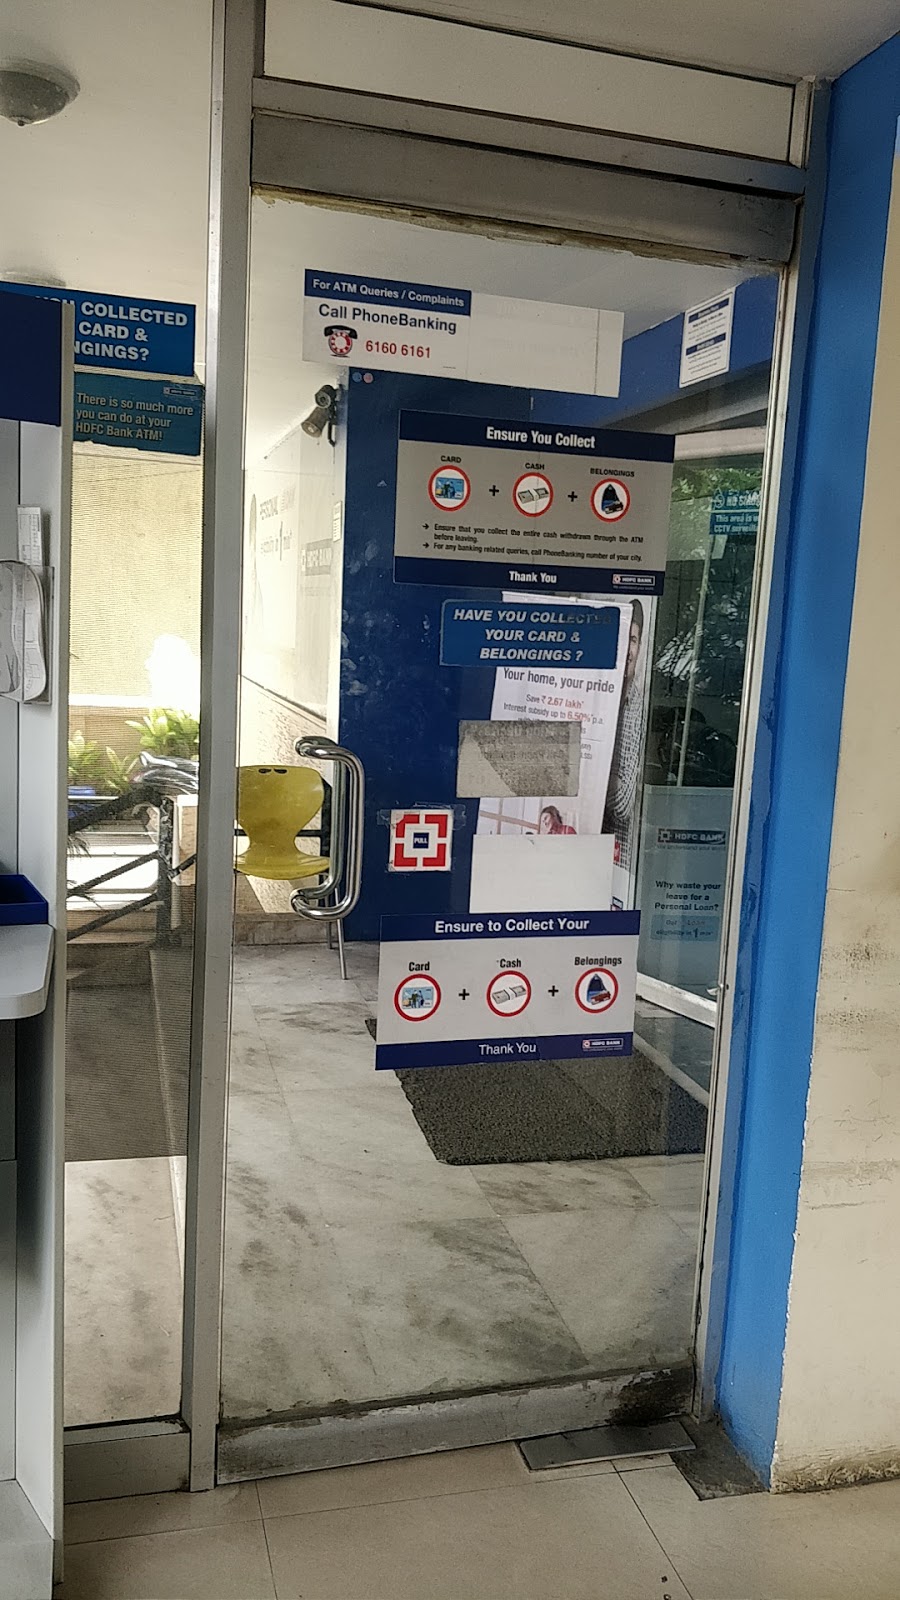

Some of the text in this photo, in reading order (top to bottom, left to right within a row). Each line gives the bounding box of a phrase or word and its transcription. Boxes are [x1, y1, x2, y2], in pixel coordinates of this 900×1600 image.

[313, 279, 331, 290] For
[333, 282, 357, 293] ATM
[359, 285, 399, 299] Queries
[408, 290, 465, 307] Complaints
[81, 301, 188, 326] COLLECTED
[319, 303, 457, 335] Call PhoneBanking
[78, 321, 148, 342] CARD &
[365, 340, 431, 358] 6160 6161
[76, 392, 194, 416] There is so much more
[76, 409, 172, 428] you can do at your
[75, 422, 163, 441] HDFC Bank ATM!
[486, 426, 596, 449] Ensure You Collect
[440, 455, 462, 464] CARD
[525, 462, 545, 471] CASH
[590, 467, 635, 478] BELONGINGS
[434, 523, 456, 532] Ensure
[560, 532, 591, 540] withdrawn
[594, 534, 616, 542] through
[714, 525, 731, 533] CCTV
[434, 533, 454, 541] before
[457, 544, 482, 553] banking
[543, 549, 585, 559] PhoneBanking
[508, 570, 557, 584] Thank You
[454, 608, 493, 621] HAVE
[498, 610, 526, 622] YOU
[485, 628, 580, 642] YOUR CARD &
[480, 647, 584, 661] BELONGINGS ?
[504, 667, 615, 693] Your home, your pride
[526, 694, 540, 703] Save
[547, 696, 563, 706] 2.67
[504, 702, 527, 712] Interest
[528, 706, 549, 717] subsidy
[655, 880, 674, 889] Why
[655, 902, 692, 910] Personal
[435, 918, 590, 934] Ensure to Collect Your
[408, 961, 430, 972] Card
[500, 958, 522, 968] Cash
[574, 956, 623, 967] Belongings
[479, 1043, 537, 1056] Thank You
